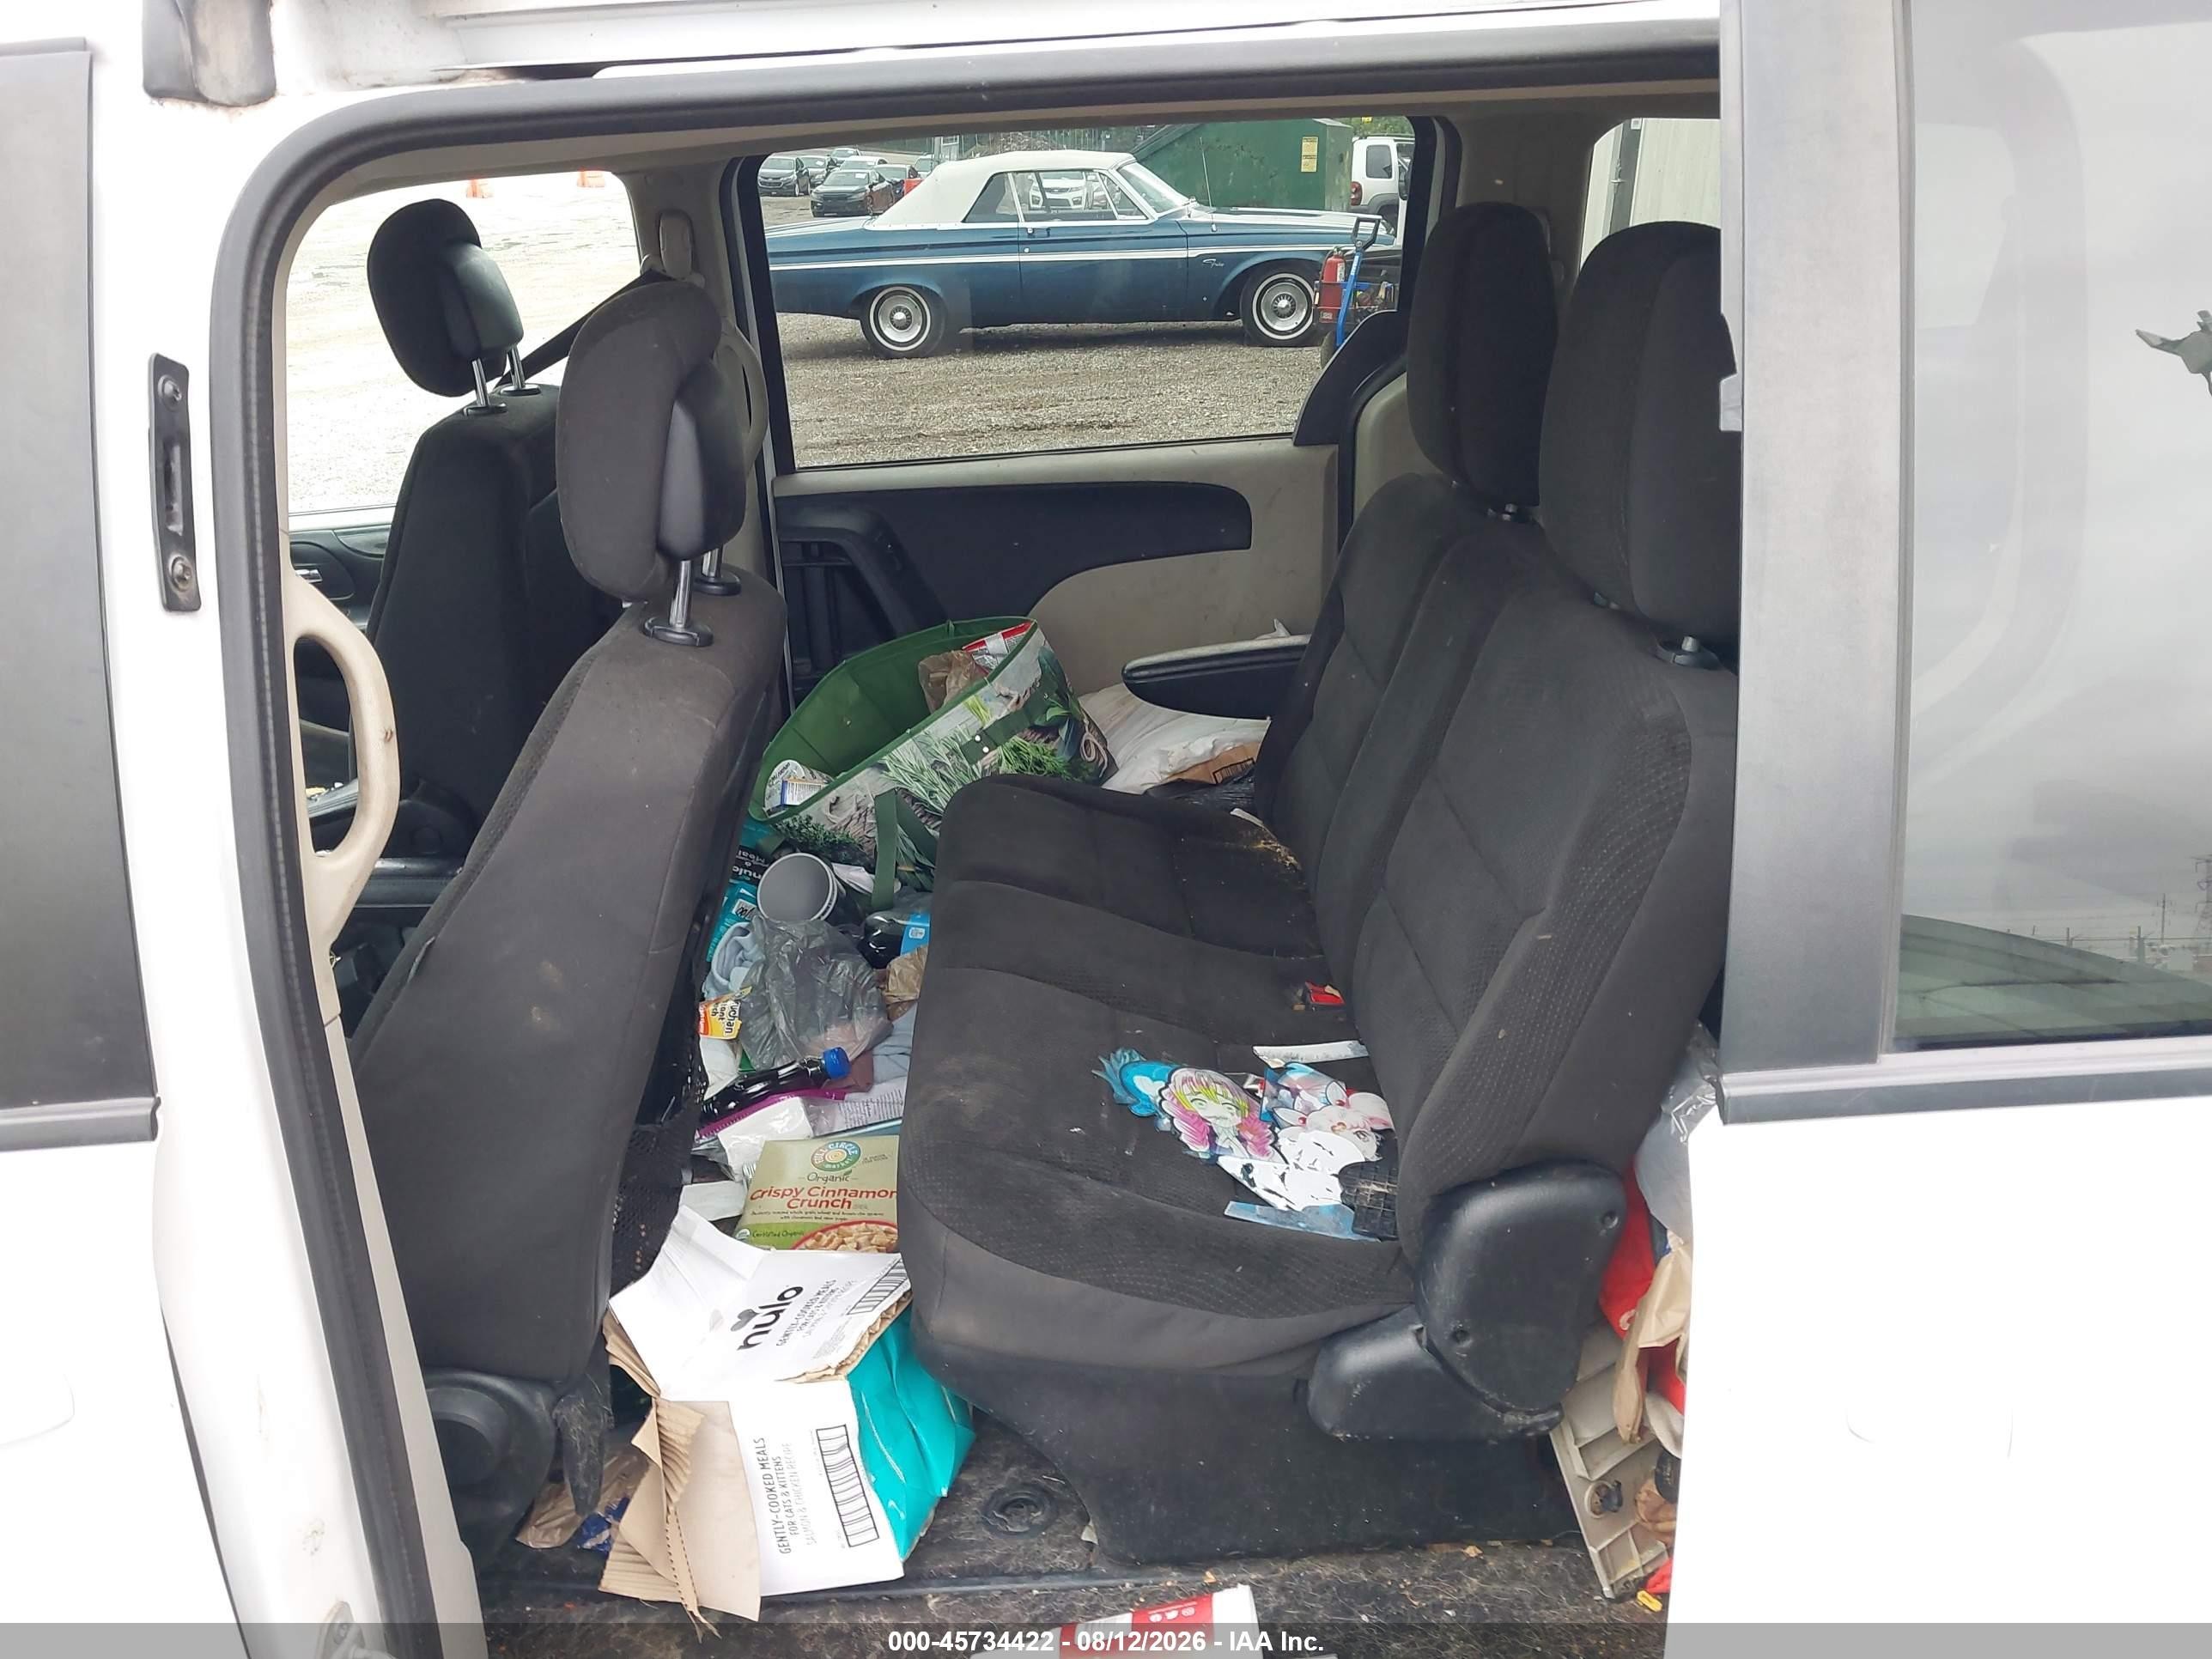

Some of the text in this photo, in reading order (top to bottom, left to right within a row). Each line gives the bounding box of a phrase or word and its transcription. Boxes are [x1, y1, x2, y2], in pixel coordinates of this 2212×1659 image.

[829, 1142, 858, 1156] CIRCLE
[807, 1171, 849, 1184] Organic
[750, 1186, 805, 1200] Crispy
[787, 1197, 852, 1210] Crunch
[737, 1286, 804, 1351] nulo
[772, 1455, 788, 1489] KITTENS
[753, 1437, 792, 1554] GENTLY-COOKED MEALS
[783, 1498, 795, 1518] CATS
[787, 1520, 799, 1535] FOR
